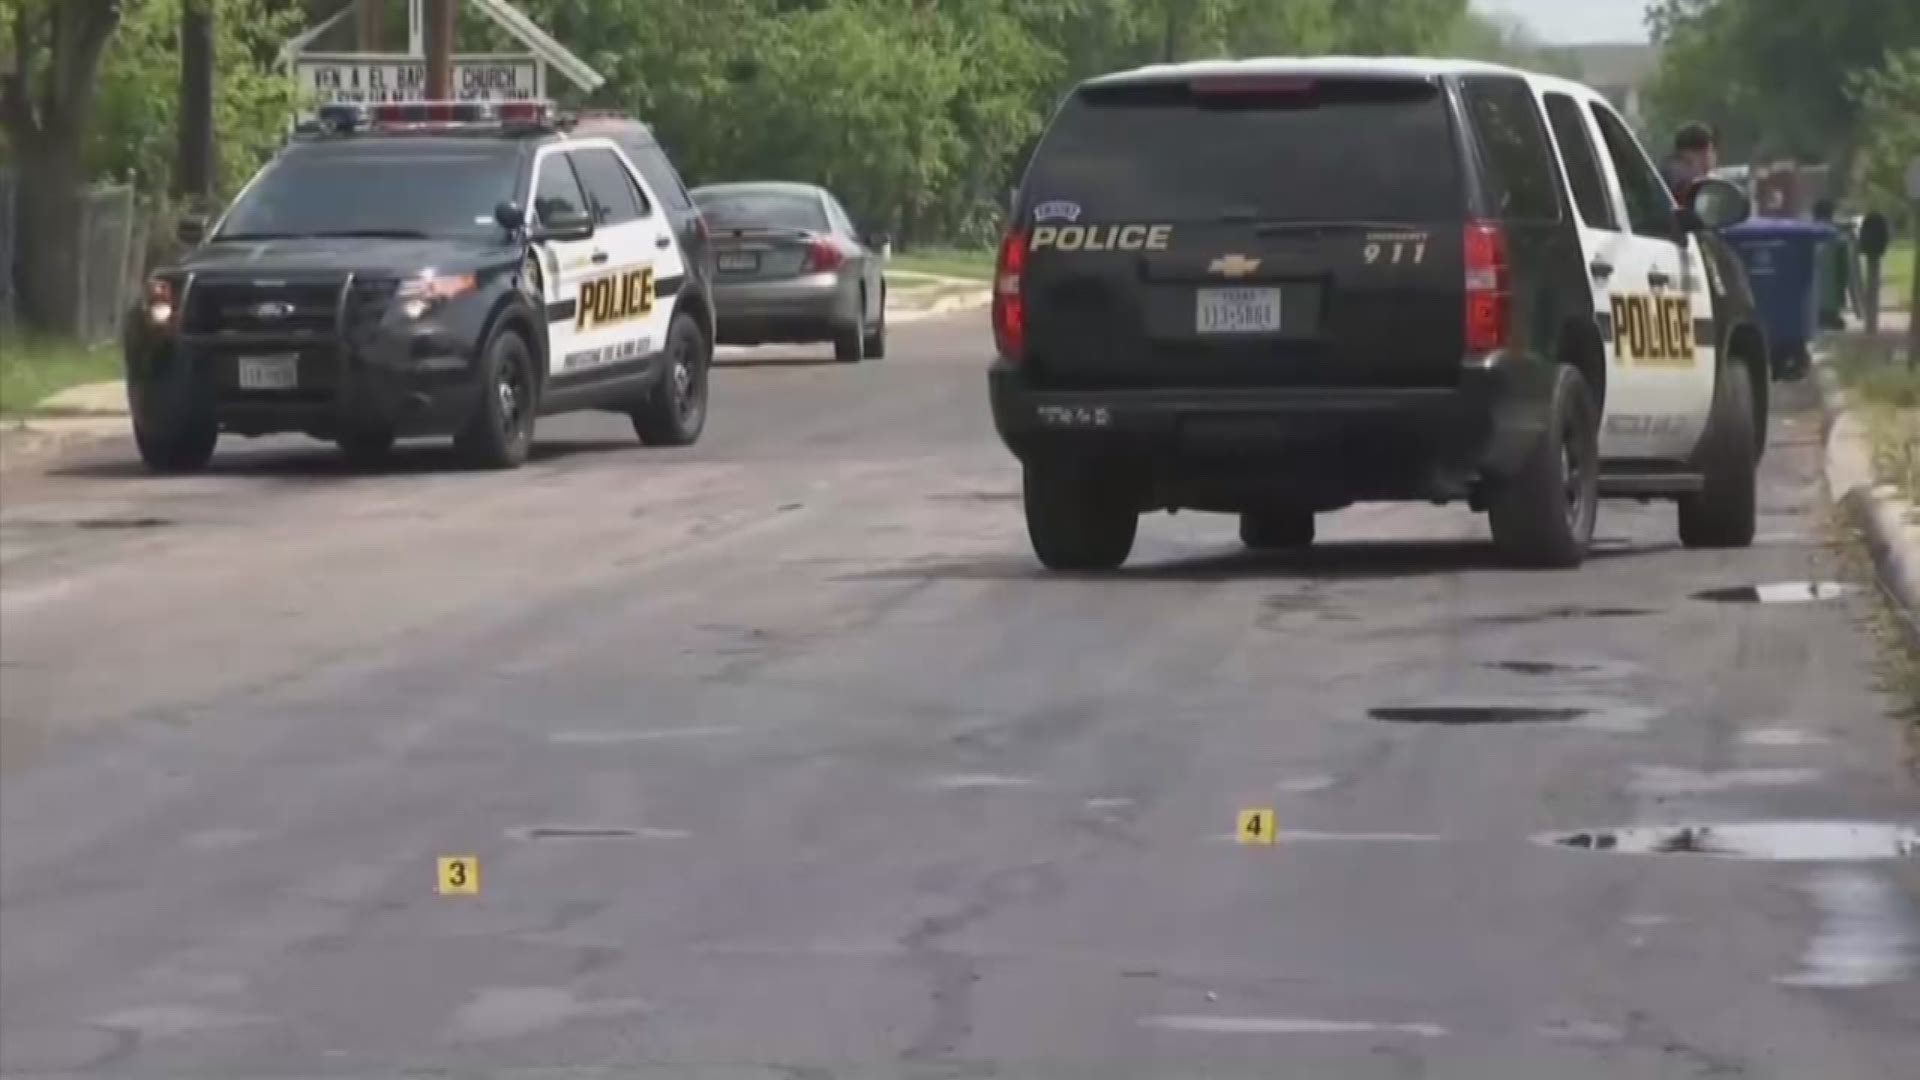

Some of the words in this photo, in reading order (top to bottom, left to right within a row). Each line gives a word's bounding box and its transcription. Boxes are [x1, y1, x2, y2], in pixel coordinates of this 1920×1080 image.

[462, 66, 516, 89] CHURCH
[1029, 224, 1173, 251] POLICE
[577, 265, 653, 332] POLICE
[1610, 294, 1694, 364] POLICE
[1246, 813, 1261, 836] 4
[449, 861, 466, 887] 3
